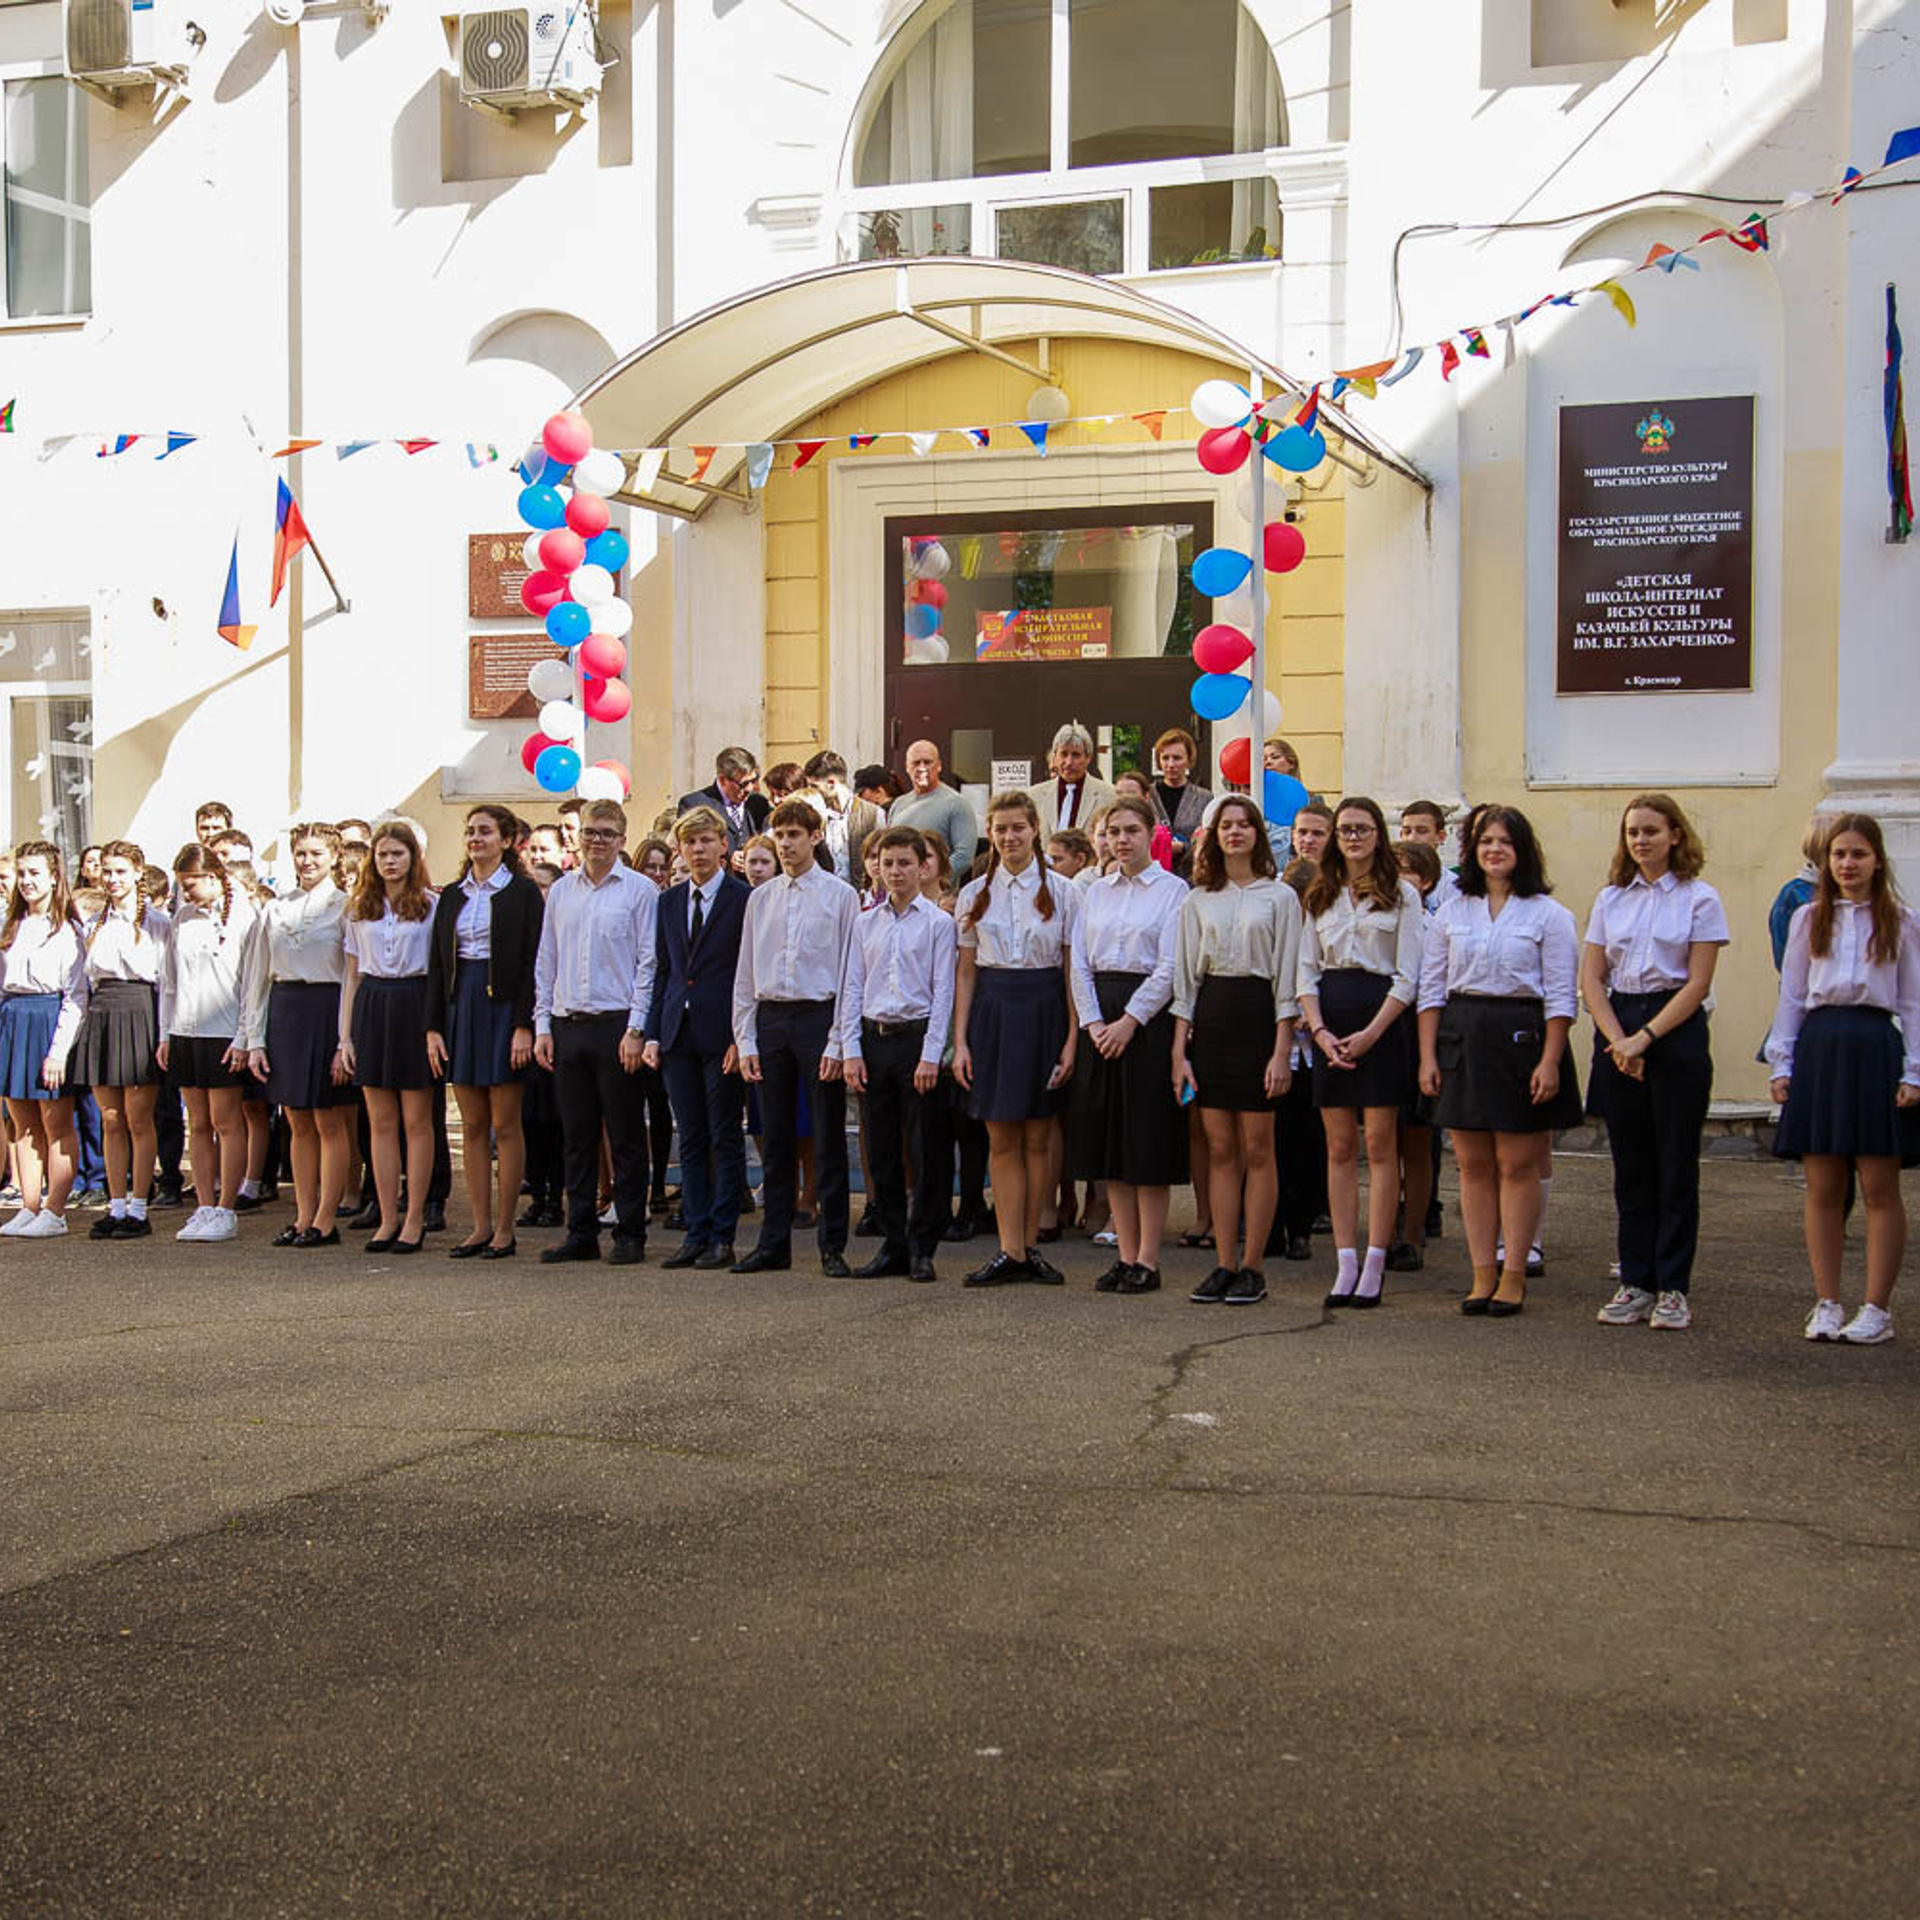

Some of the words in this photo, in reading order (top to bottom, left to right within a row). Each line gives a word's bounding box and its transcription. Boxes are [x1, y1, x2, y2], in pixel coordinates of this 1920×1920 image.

[1584, 465, 1669, 477] МИНИСТЕРСТВО
[1672, 461, 1728, 473] КУЛЬТУРЫ
[1593, 475, 1689, 487] КРАСНОДАРСКОГО
[1691, 473, 1718, 483] КРАЯ
[1568, 514, 1670, 527] ГОСУДАРСТВЕННОЕ
[1672, 511, 1742, 522] БЮДЖЕТНОЕ
[1568, 525, 1667, 537] ОБРАЗОВАТЕЛЬНОЕ
[1669, 522, 1742, 533] УЧРЕЖДЕНИЕ
[1593, 535, 1689, 547] КРАСНОДАРСКОГО
[1690, 533, 1717, 543] КРАЯ
[1616, 574, 1692, 588] «ДЕТСКАЯ
[1585, 587, 1724, 604] ШКОЛА-ИНТЕРНАТ
[1607, 604, 1687, 618] ИСКУССТВ
[1689, 603, 1701, 616] И
[1576, 619, 1650, 635] КАЗАЧЬЕЙ
[1653, 618, 1733, 632] КУЛЬТУРЫ
[1573, 637, 1601, 650] ИМ.
[1604, 637, 1627, 649] В.Г.
[1630, 634, 1735, 648] ЗАХАРЧЕНКО»
[998, 764, 1027, 775] ВХОД
